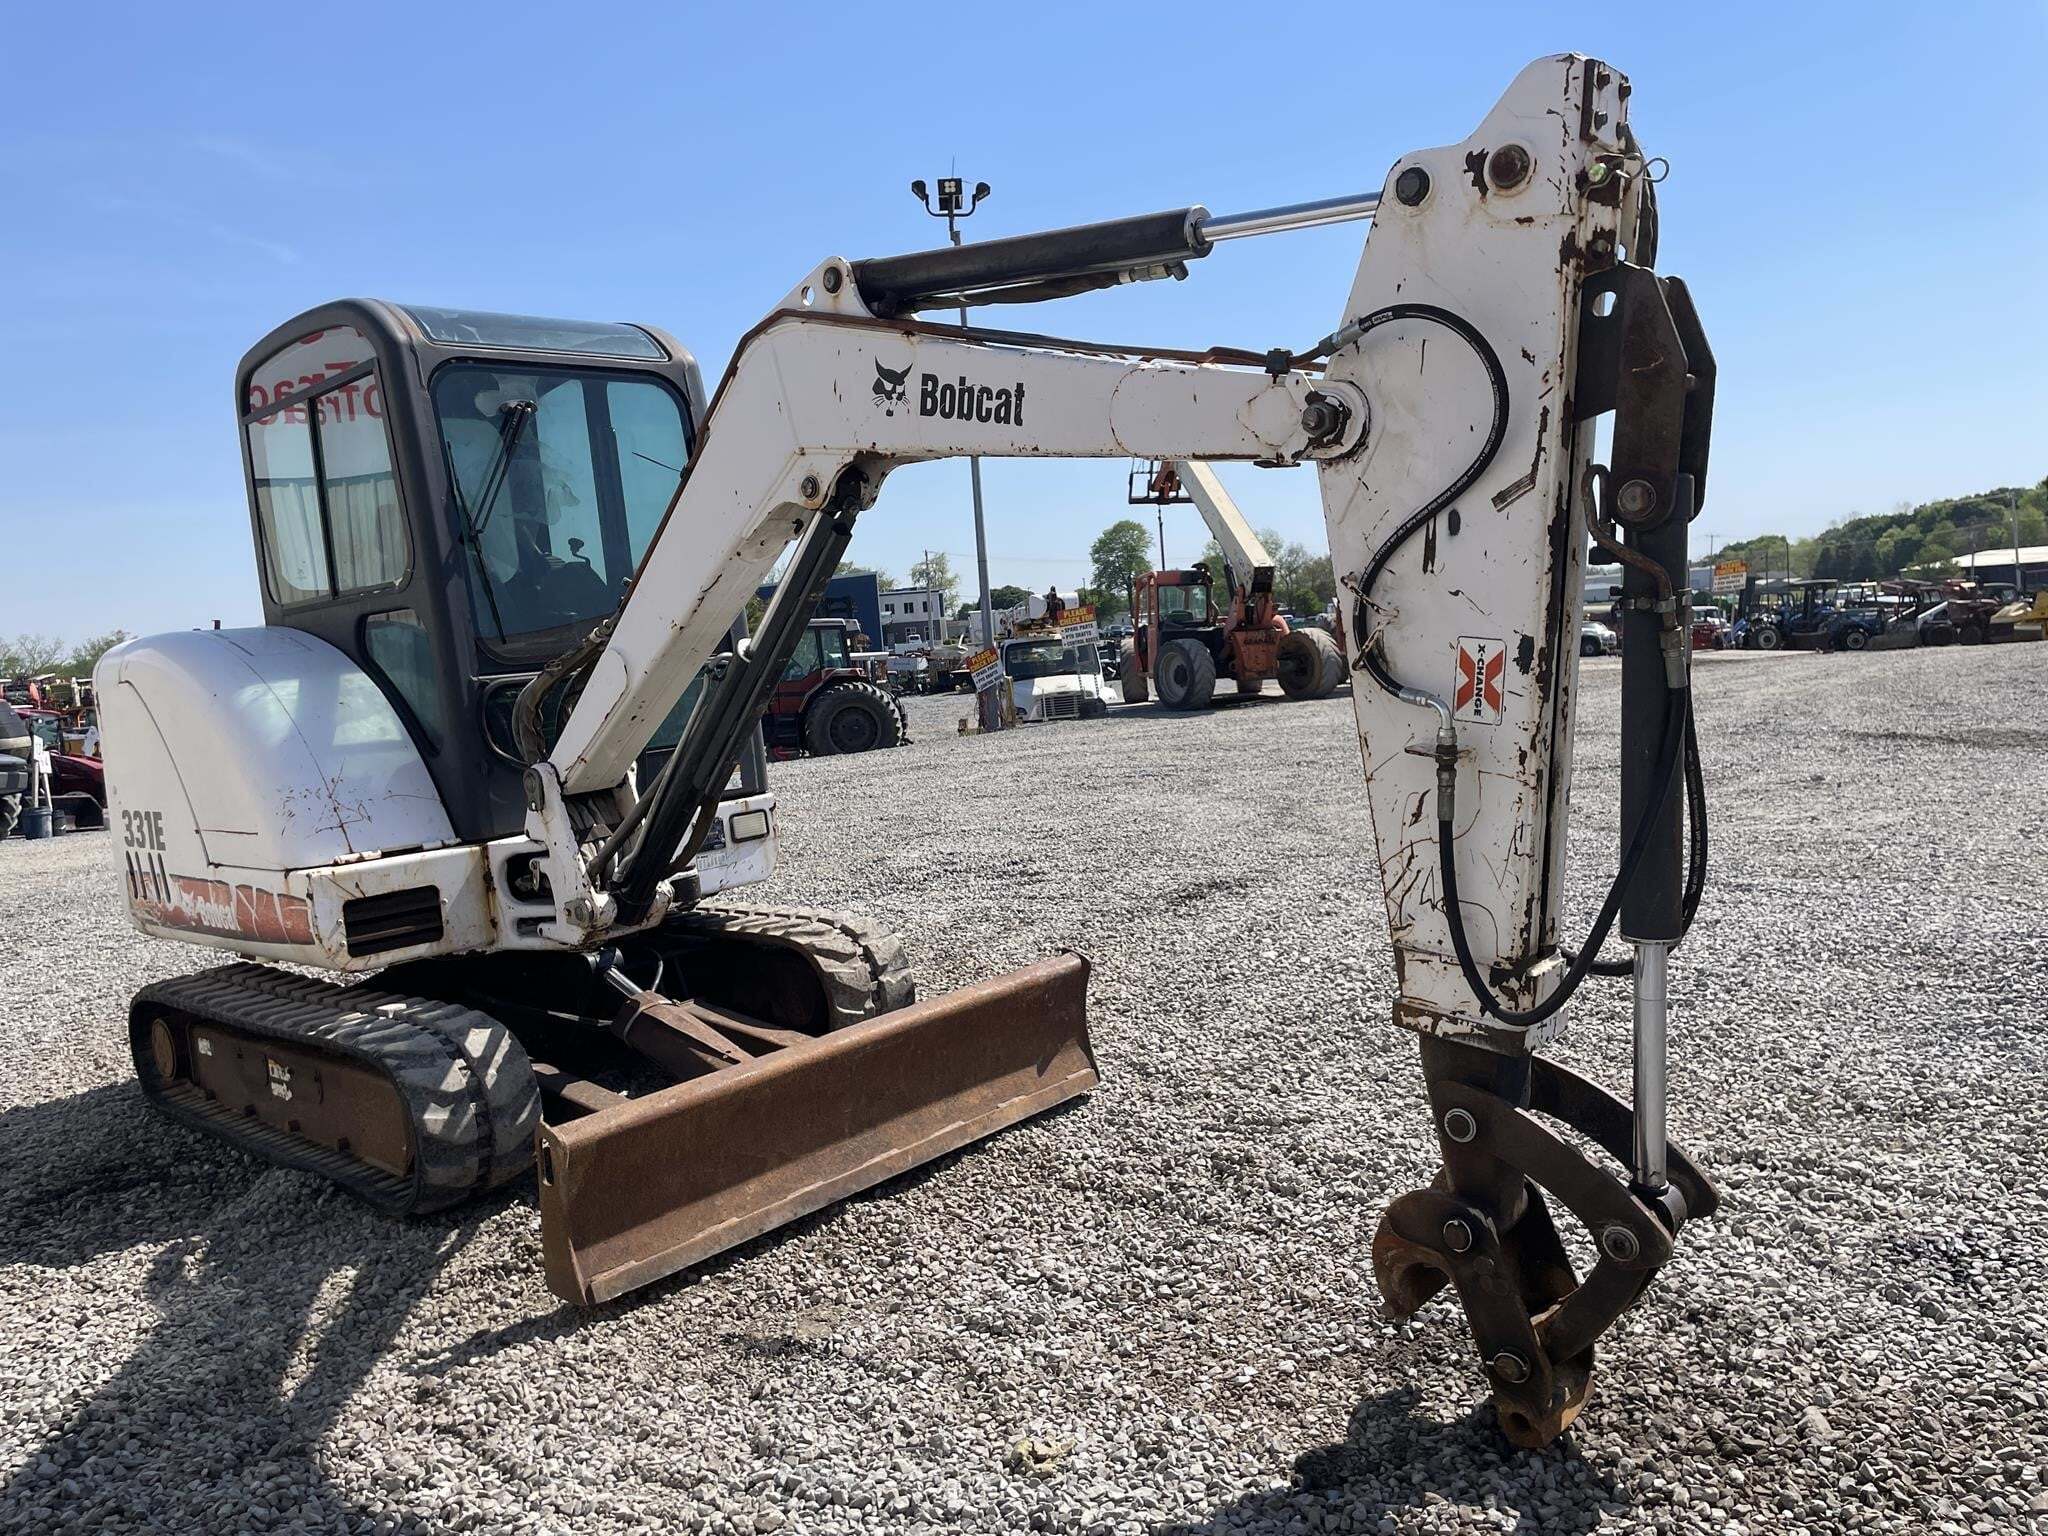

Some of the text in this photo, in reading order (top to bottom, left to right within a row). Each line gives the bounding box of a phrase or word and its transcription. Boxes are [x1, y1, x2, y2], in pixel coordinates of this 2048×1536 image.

[919, 373, 1025, 427] Bobcat
[1474, 644, 1486, 717] X-CHANGE
[122, 810, 166, 851] 331E
